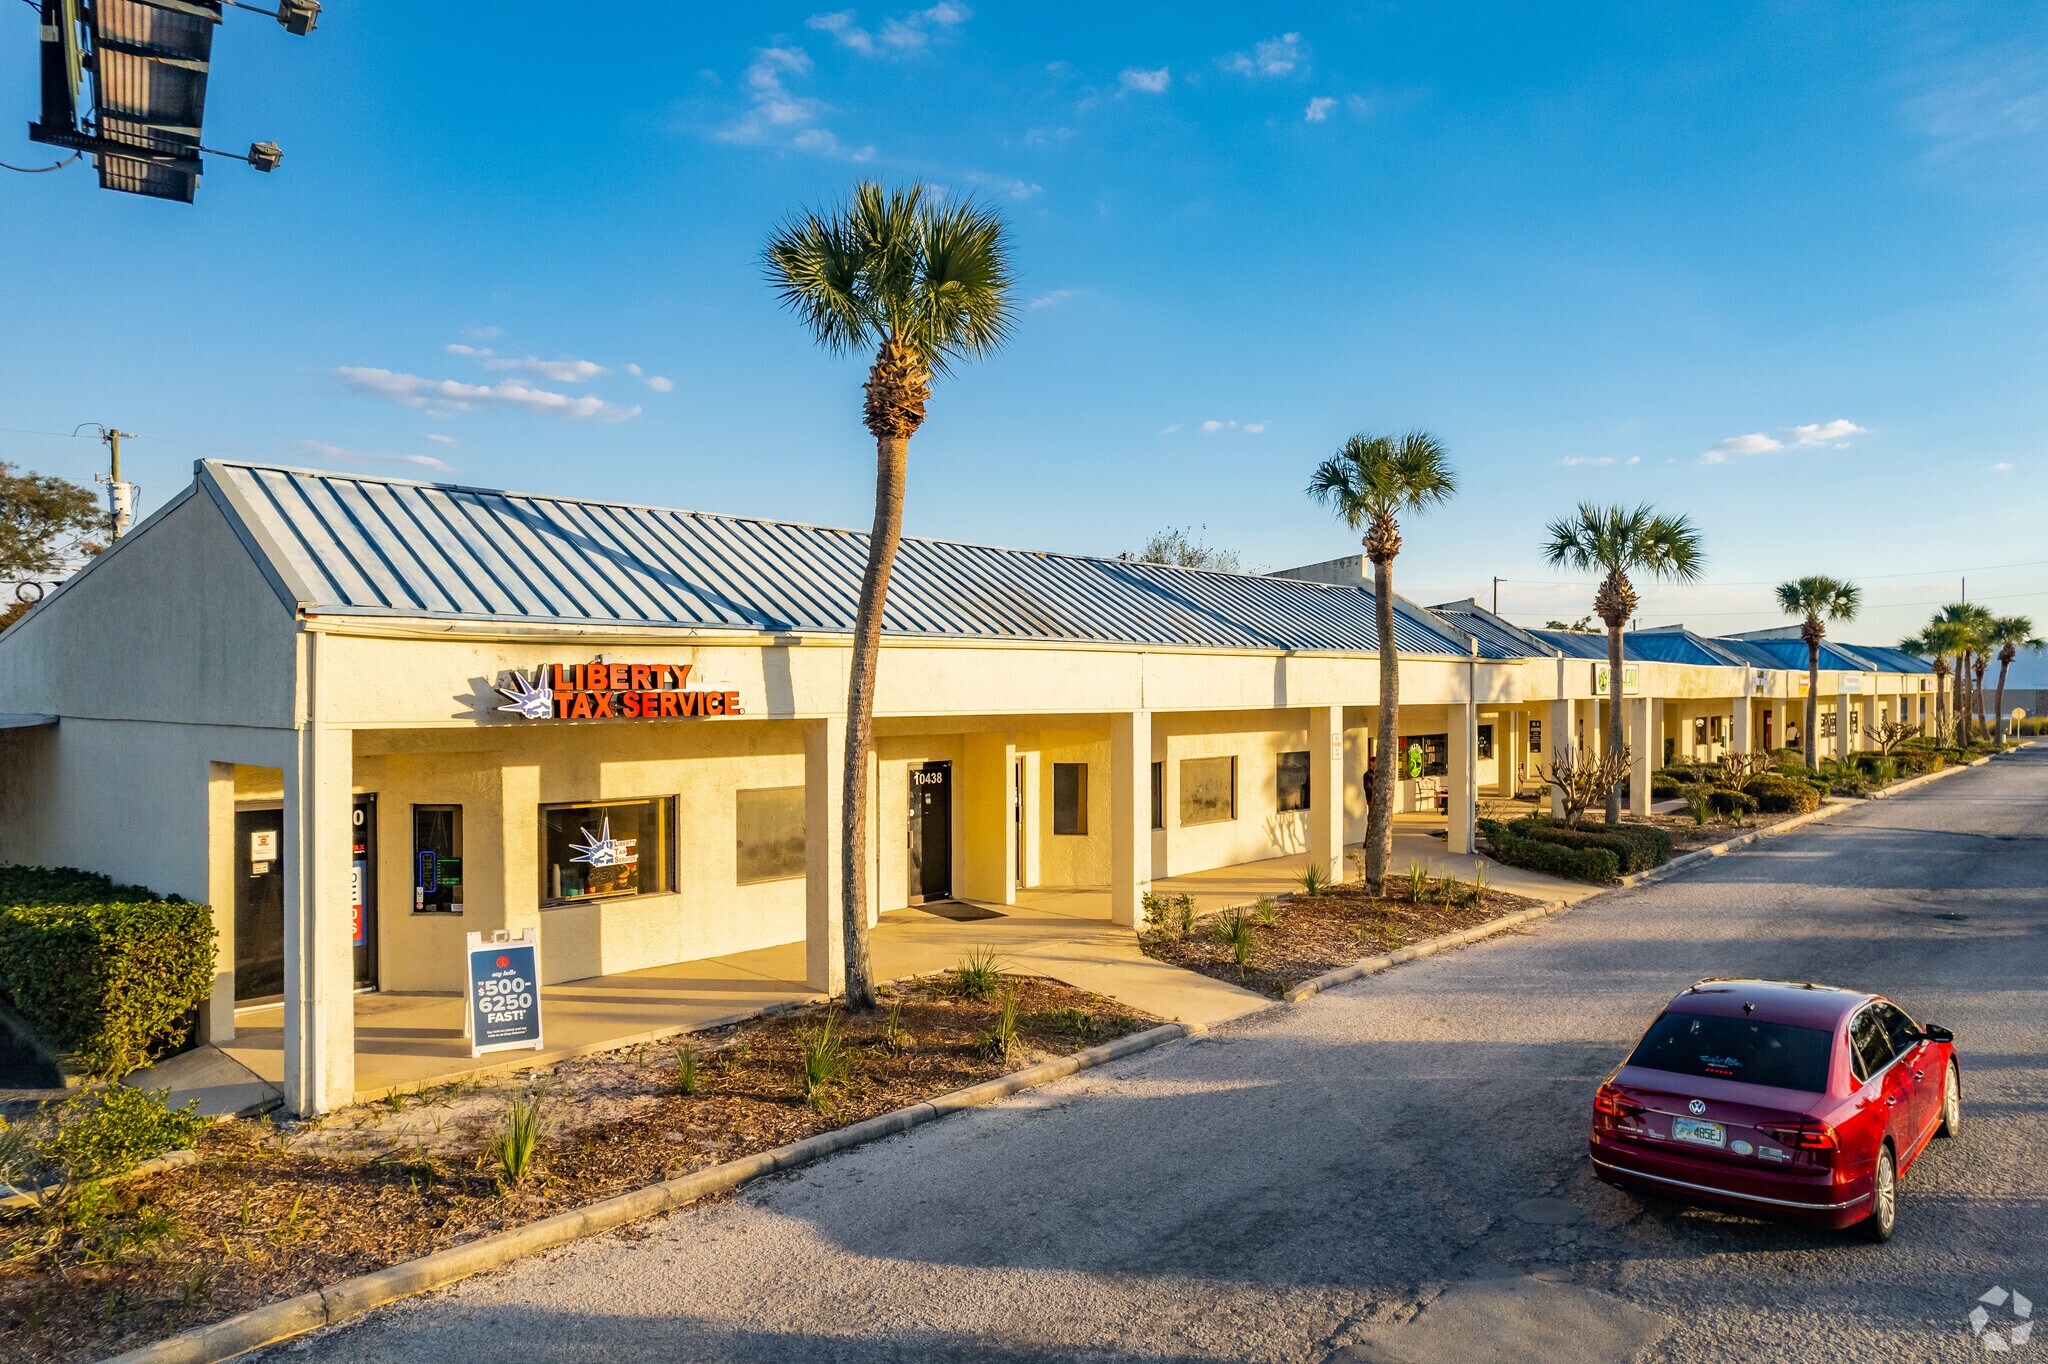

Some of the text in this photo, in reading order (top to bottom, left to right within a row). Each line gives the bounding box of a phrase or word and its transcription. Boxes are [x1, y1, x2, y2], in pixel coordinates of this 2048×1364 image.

[553, 663, 692, 690] LIBERTY
[553, 691, 741, 719] TAX SERVICE
[914, 772, 942, 785] 10438
[479, 993, 532, 1013] 6250
